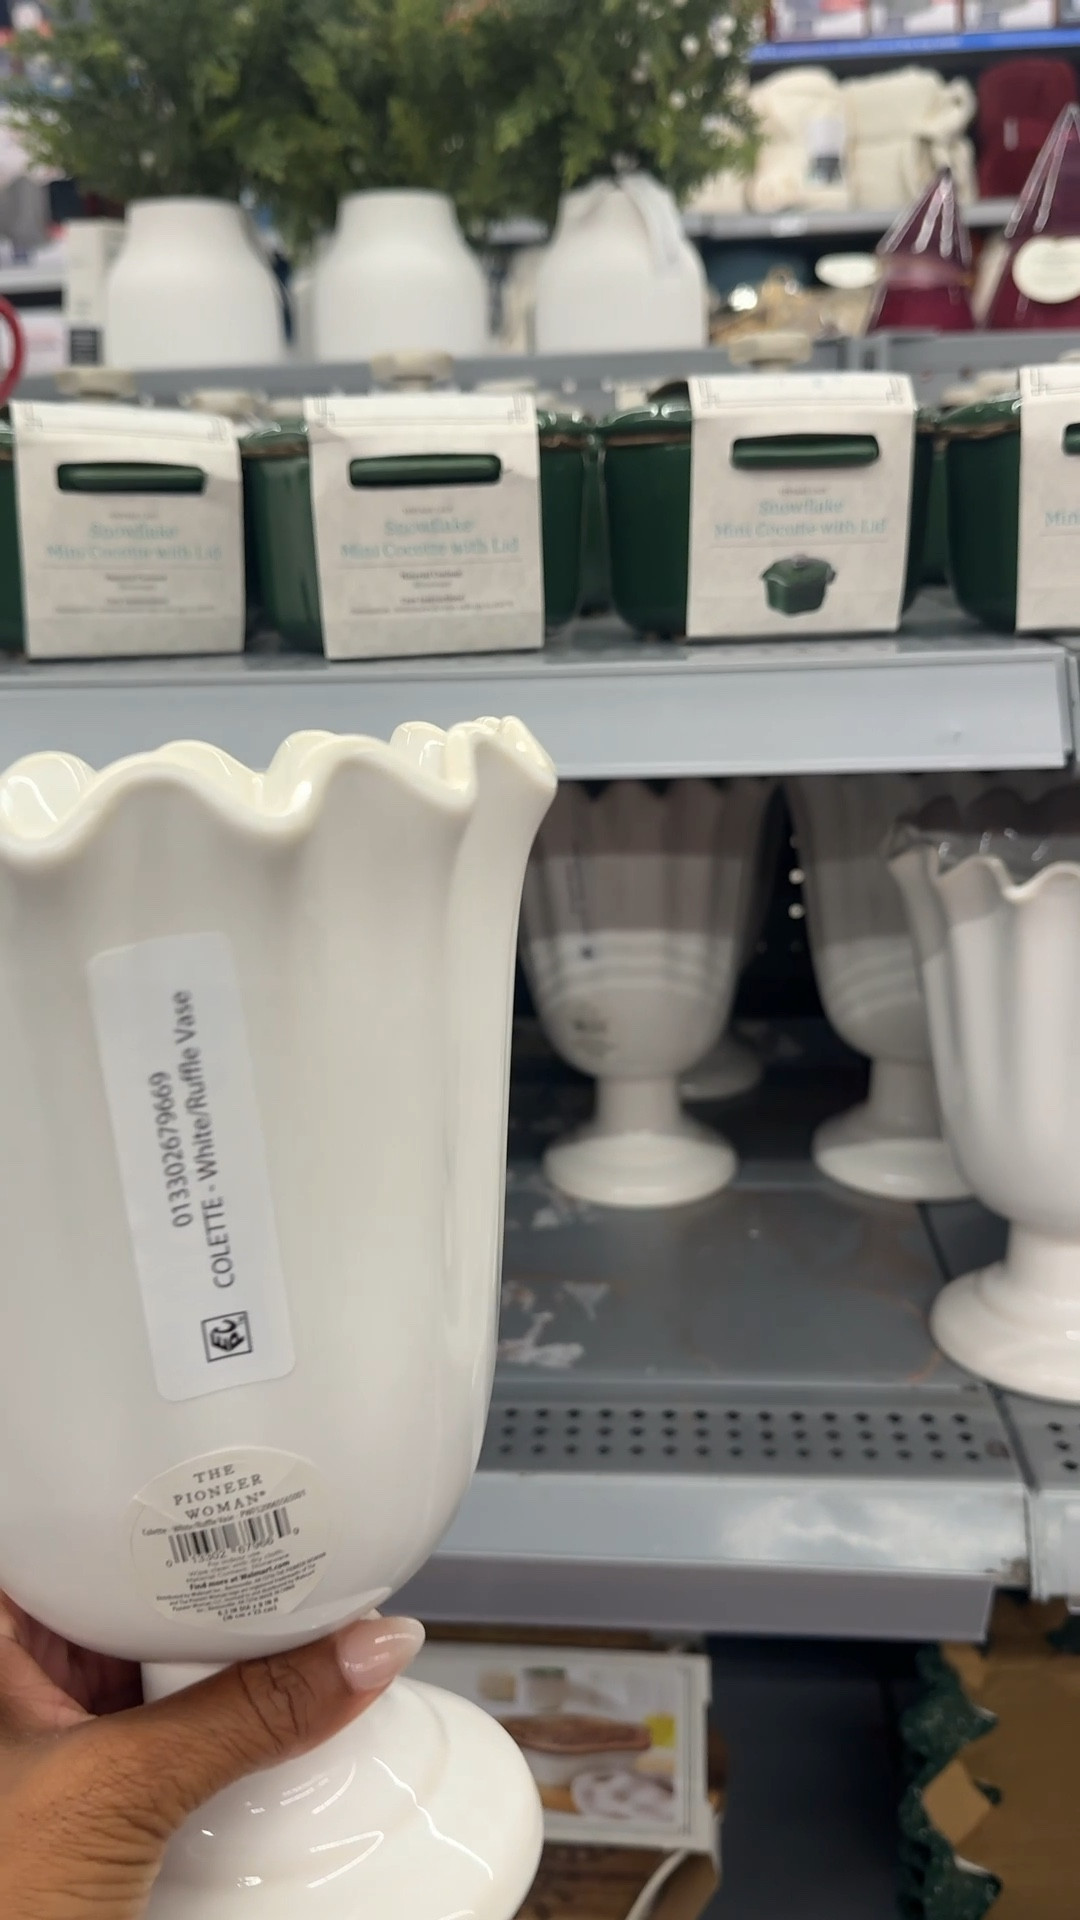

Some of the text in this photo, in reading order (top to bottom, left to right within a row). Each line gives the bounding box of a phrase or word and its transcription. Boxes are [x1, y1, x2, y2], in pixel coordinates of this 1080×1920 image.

[759, 499, 844, 515] Snowflake
[385, 518, 476, 535] Snowflake
[714, 524, 750, 540] Mini
[820, 519, 857, 535] with
[861, 517, 888, 534] Lid
[451, 538, 488, 555] with
[492, 536, 520, 553] Lid
[172, 990, 200, 1045] Vase
[178, 1047, 219, 1182] White/Ruffle
[148, 1071, 194, 1229] 013302679669
[202, 1196, 235, 1289] COLETTE
[193, 1463, 236, 1484] THE
[172, 1473, 264, 1507] PIONEER
[190, 1582, 207, 1590] Find
[208, 1579, 229, 1587] more
[240, 1561, 290, 1580] Walmart.com
